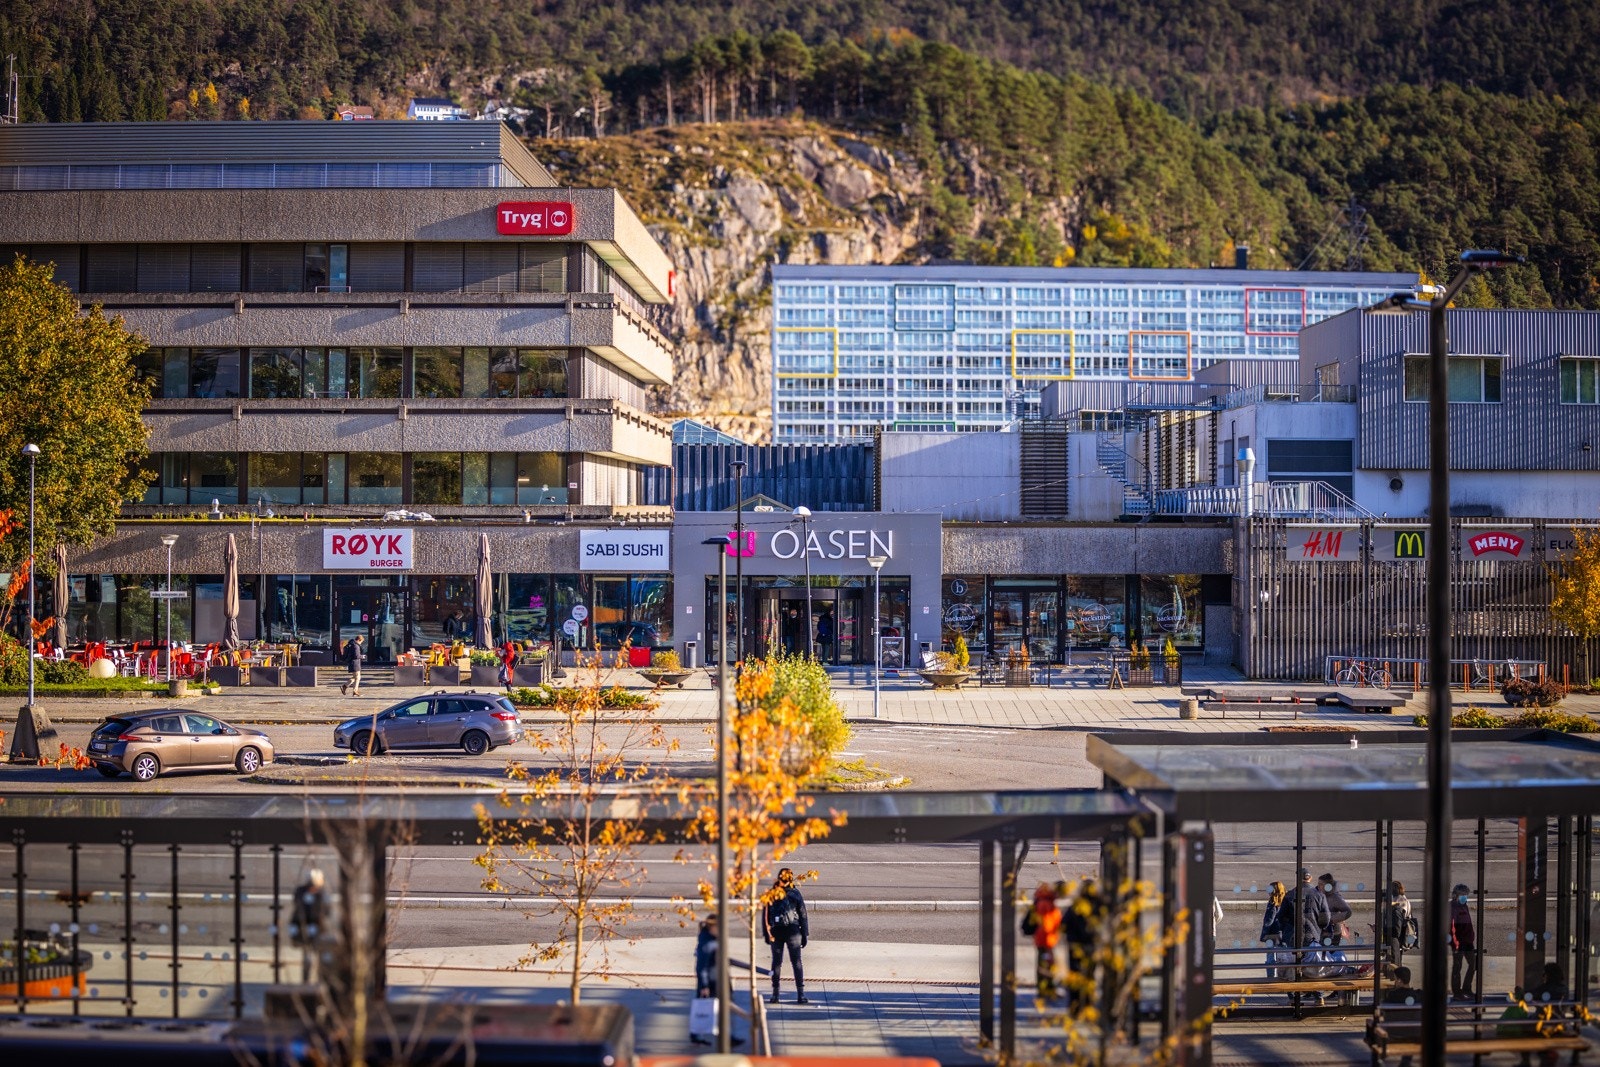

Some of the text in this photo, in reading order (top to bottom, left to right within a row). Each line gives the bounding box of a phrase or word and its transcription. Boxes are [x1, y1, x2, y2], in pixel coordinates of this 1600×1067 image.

[501, 210, 542, 228] Tryg
[332, 534, 403, 555] RØYK
[586, 543, 664, 557] SABI SUSHI
[770, 529, 893, 559] OASEN
[1303, 531, 1343, 558] H&M
[1475, 536, 1519, 550] MENY
[370, 559, 403, 567] BURGER
[1080, 614, 1111, 622] backstube
